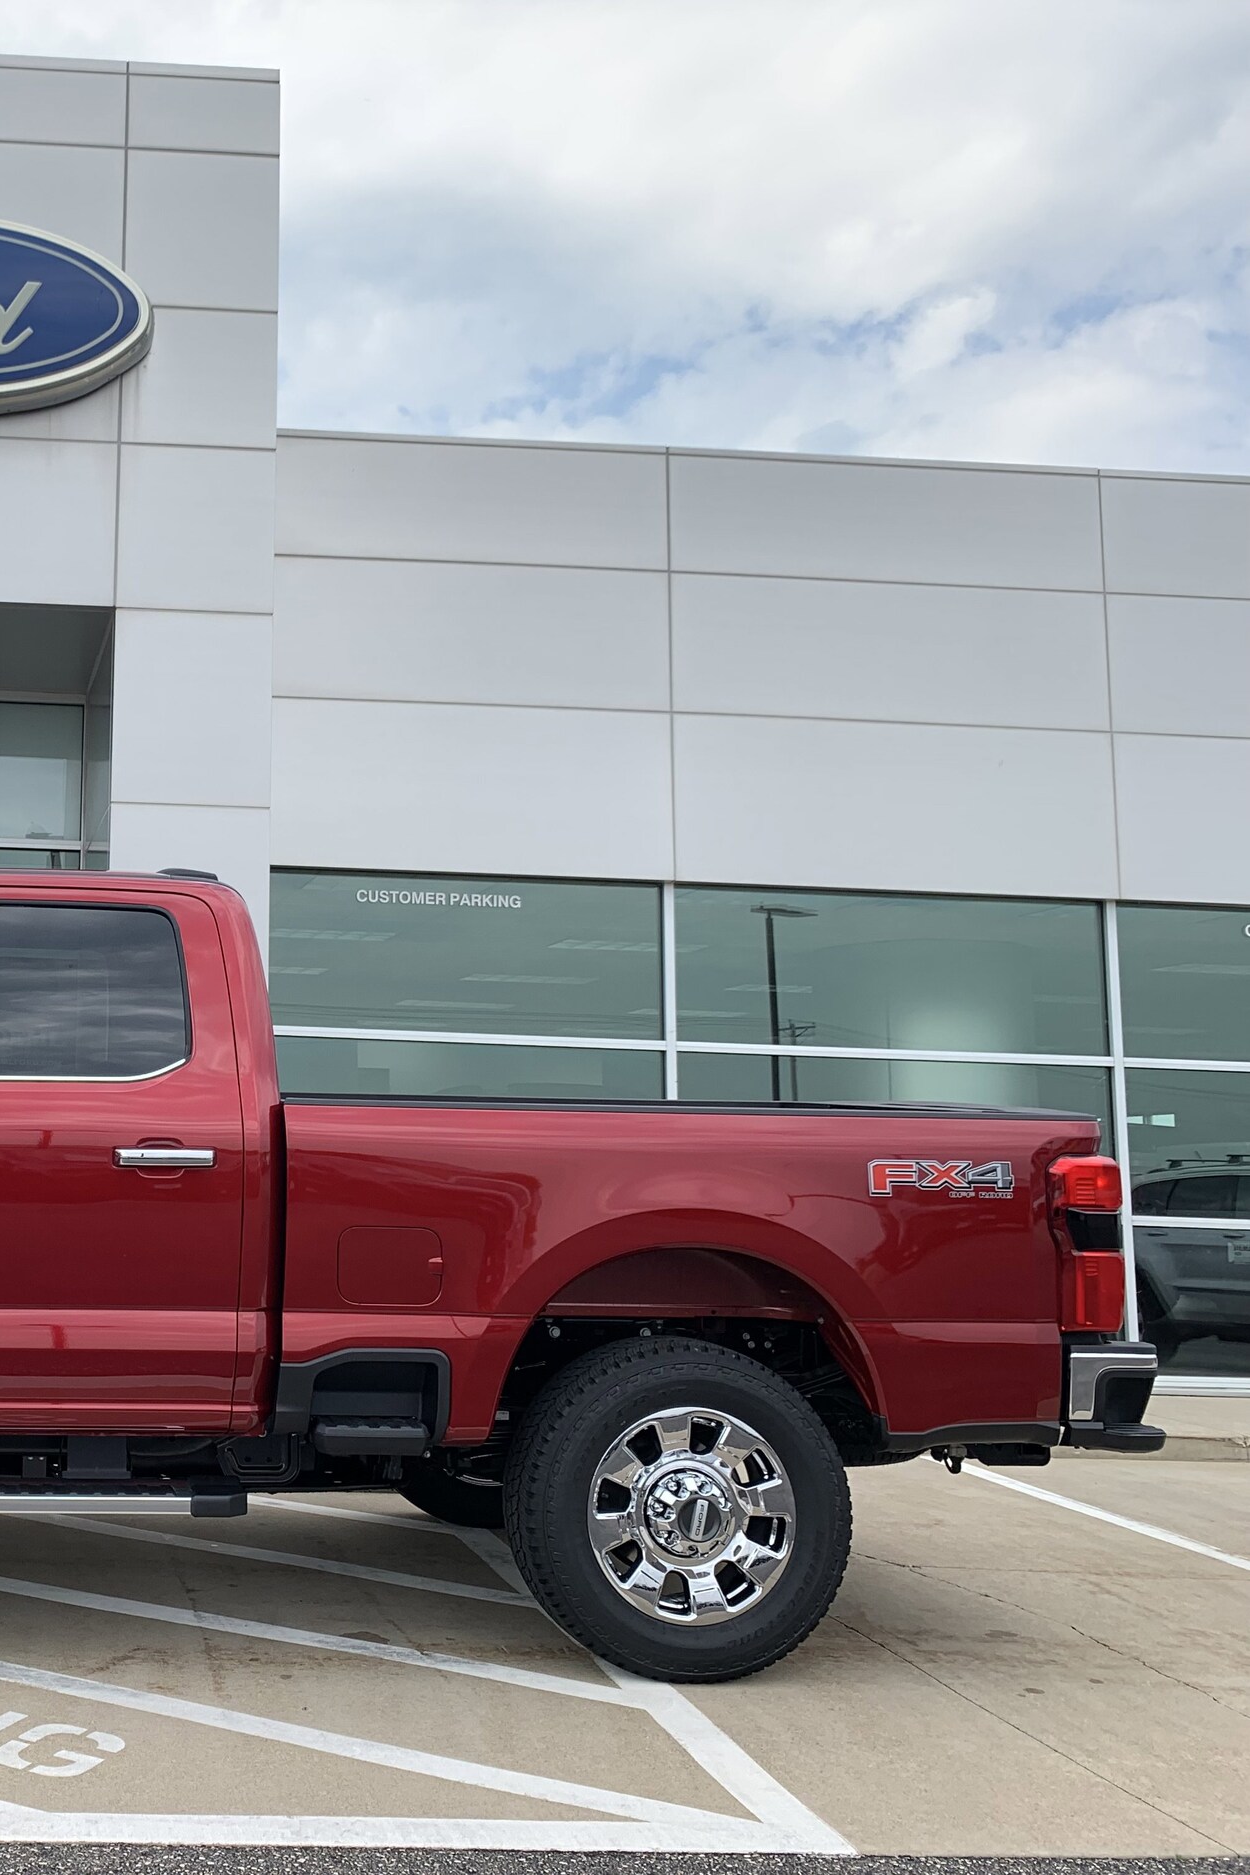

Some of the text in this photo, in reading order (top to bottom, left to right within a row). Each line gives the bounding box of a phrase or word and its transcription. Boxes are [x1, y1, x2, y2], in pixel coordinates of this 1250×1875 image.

[356, 889, 522, 909] CUSTOMER PARKING
[868, 1159, 1014, 1197] FX4
[694, 1504, 706, 1537] FORD
